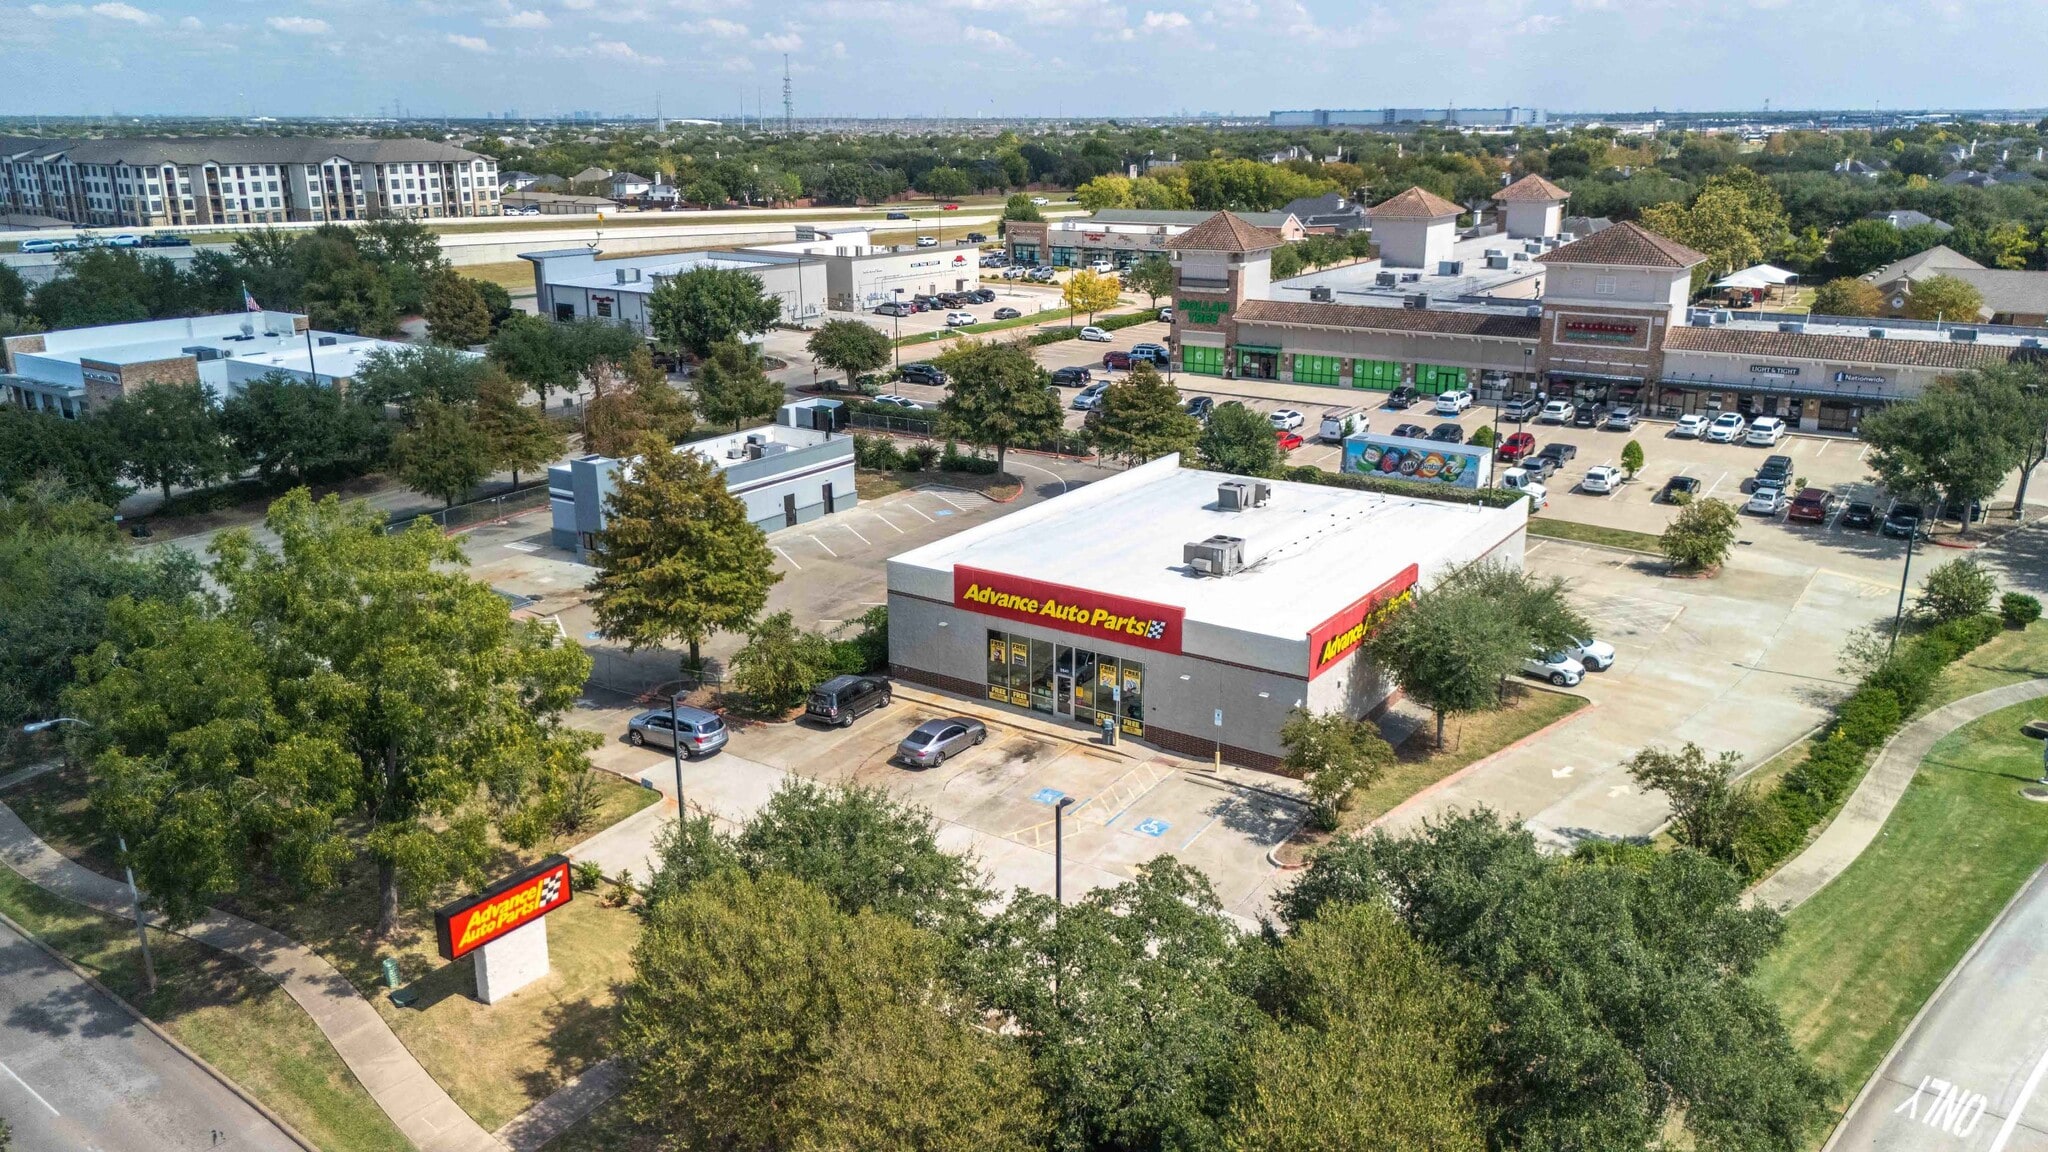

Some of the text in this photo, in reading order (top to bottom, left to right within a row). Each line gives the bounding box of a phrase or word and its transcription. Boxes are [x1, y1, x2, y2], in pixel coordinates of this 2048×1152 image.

[1845, 374, 1885, 383] Nationwide
[962, 583, 1146, 637] Advance Auto Parts
[1012, 643, 1026, 651] FREE
[1321, 622, 1364, 665] Advance
[991, 686, 1006, 695] FREE
[1012, 691, 1027, 700] FREE
[458, 900, 535, 948] Auto Parts
[466, 886, 537, 927] Advance
[1894, 1075, 1987, 1138] ONLY
